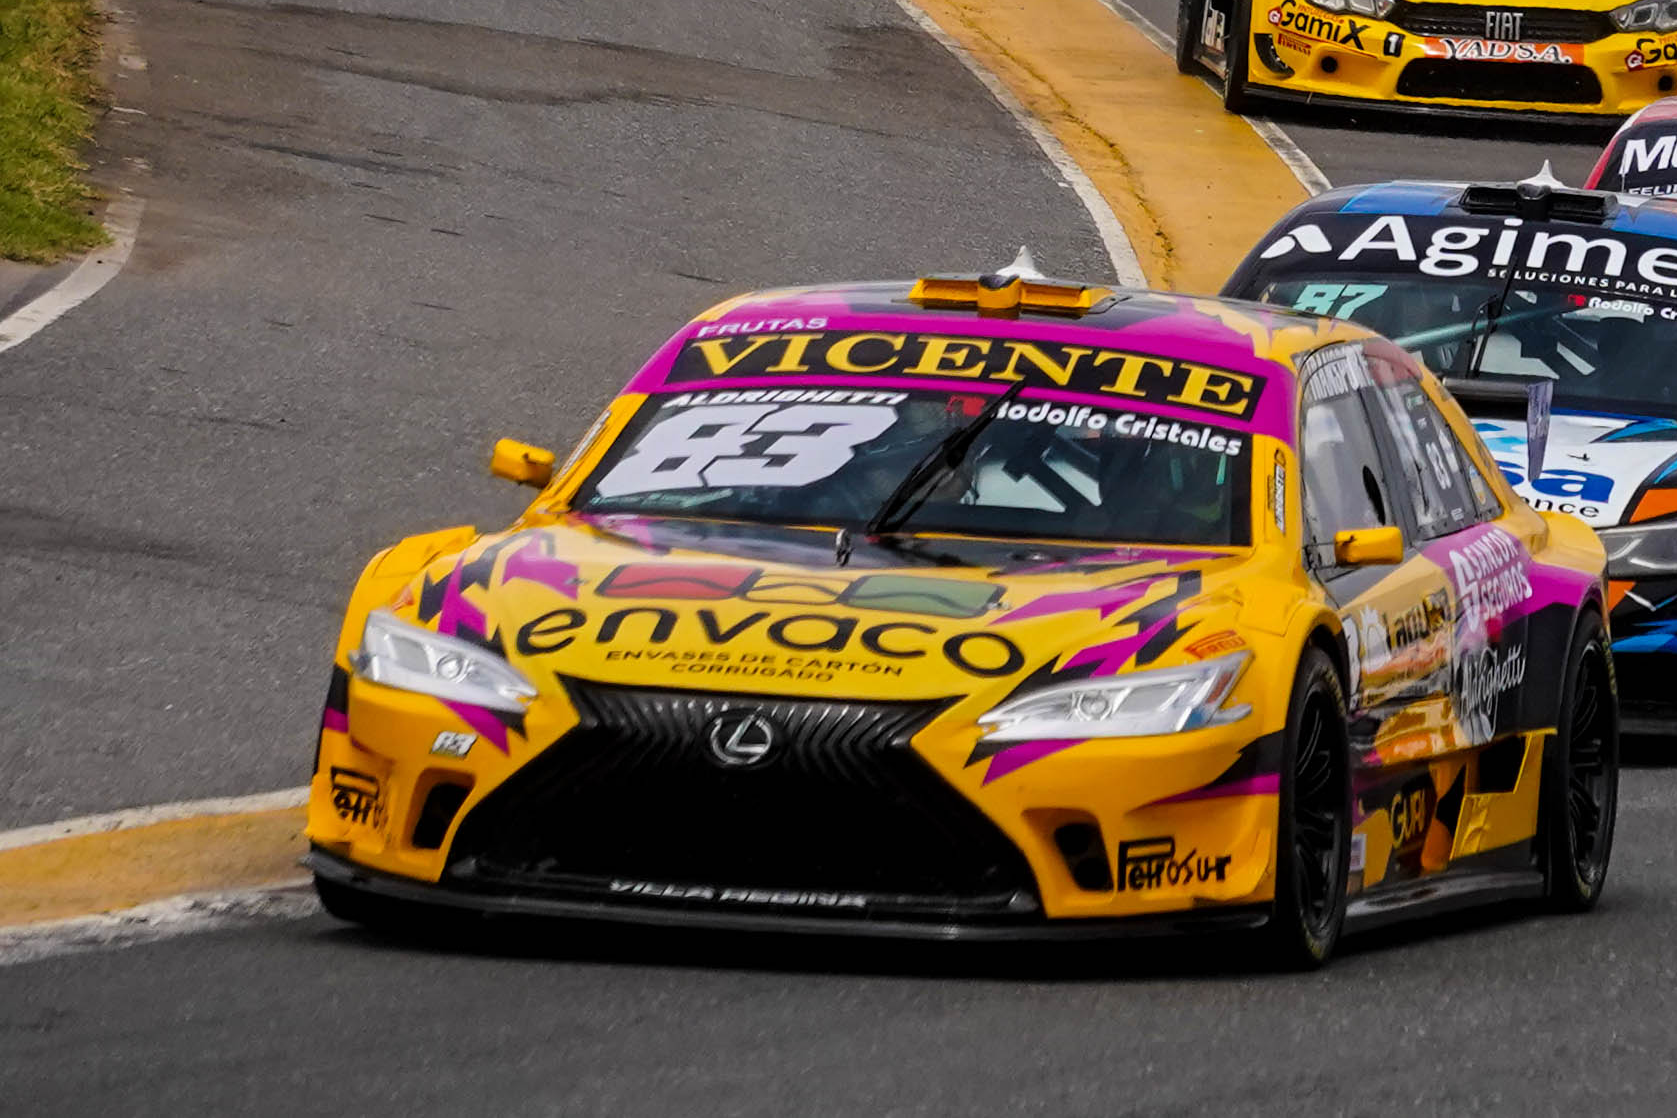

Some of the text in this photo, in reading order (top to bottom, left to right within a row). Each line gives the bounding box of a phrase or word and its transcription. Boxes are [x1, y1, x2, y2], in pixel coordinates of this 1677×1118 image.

[1485, 12, 1524, 40] FIAT
[1614, 279, 1664, 297] PARA
[1588, 296, 1654, 317] Rodolfo
[697, 317, 828, 338] FRUTAS
[691, 331, 1254, 415] VICENTE
[1113, 411, 1242, 457] Cristales
[595, 402, 899, 498] 83
[516, 602, 1027, 678] envaco
[605, 649, 903, 678] ENVASES DE CARTÓN
[671, 663, 834, 684] CORRUGADO
